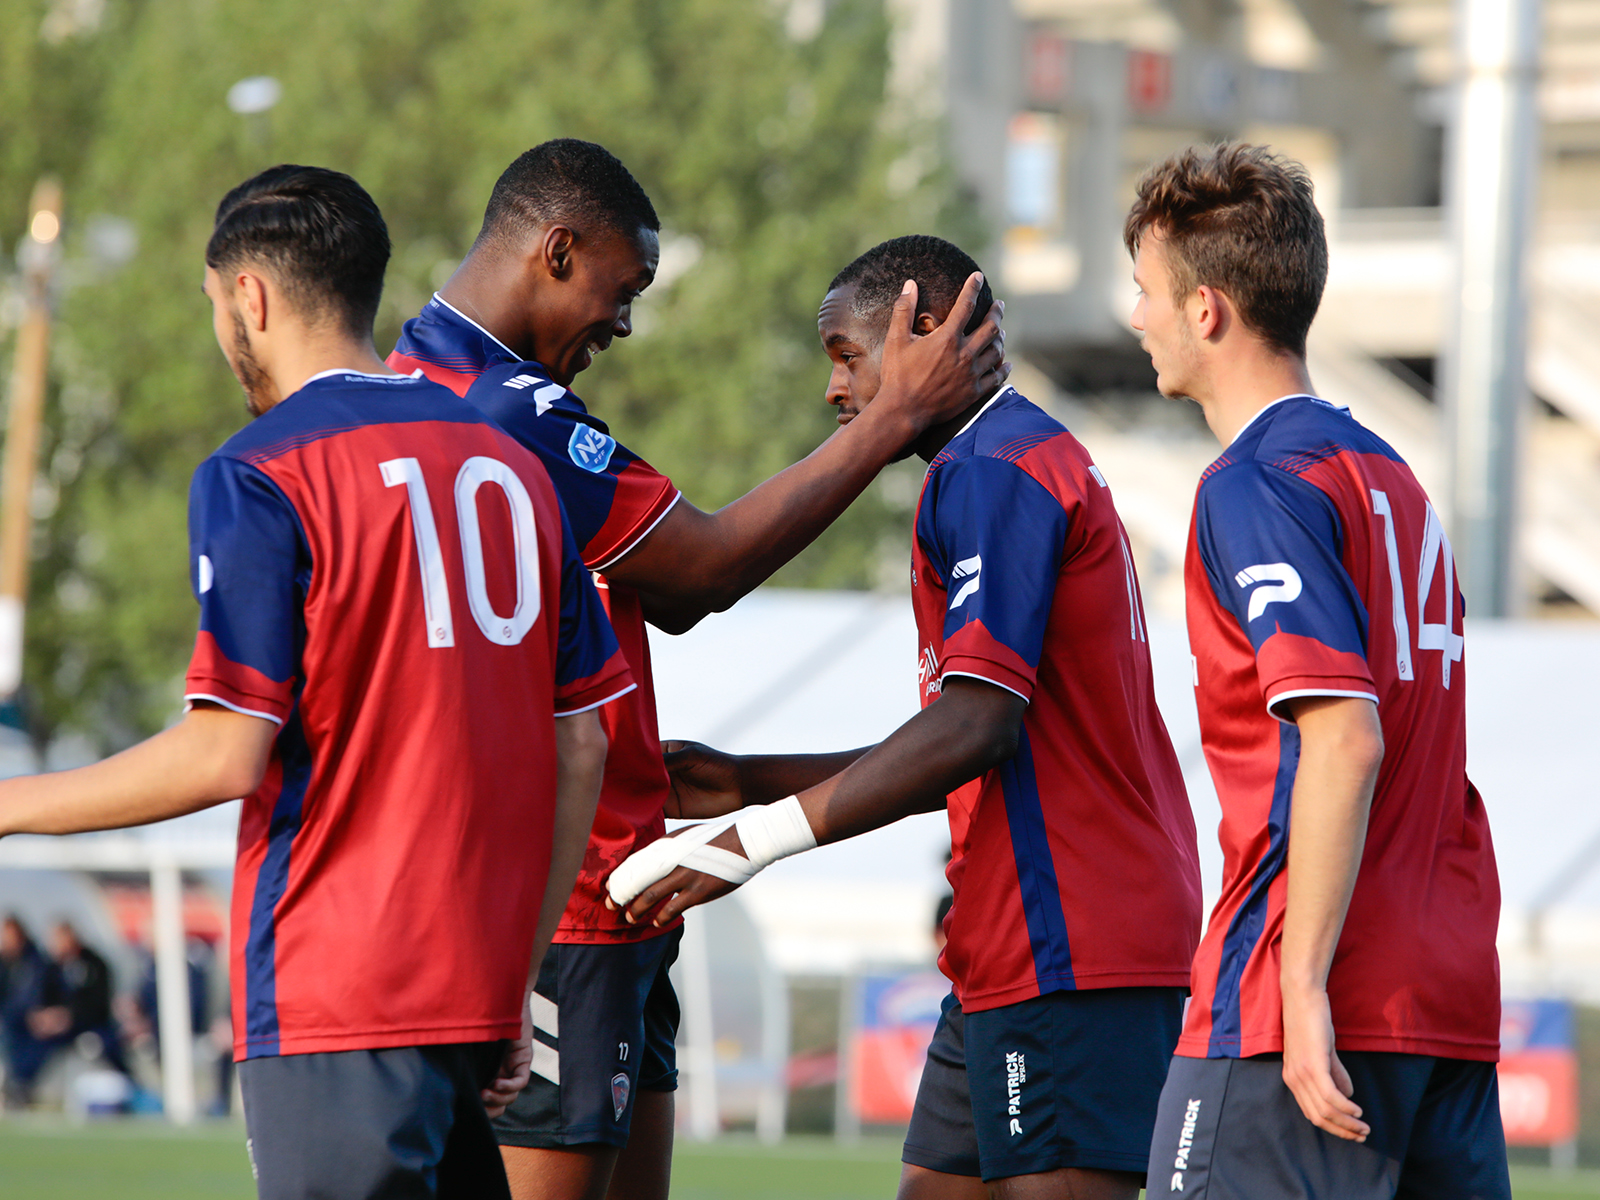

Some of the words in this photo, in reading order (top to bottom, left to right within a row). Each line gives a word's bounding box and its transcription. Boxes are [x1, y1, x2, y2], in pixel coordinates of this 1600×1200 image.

[575, 427, 607, 464] N3
[379, 455, 541, 649] 10
[1369, 488, 1464, 691] 14
[1006, 1051, 1021, 1116] PATRICK
[1174, 1098, 1202, 1171] PATRICK
